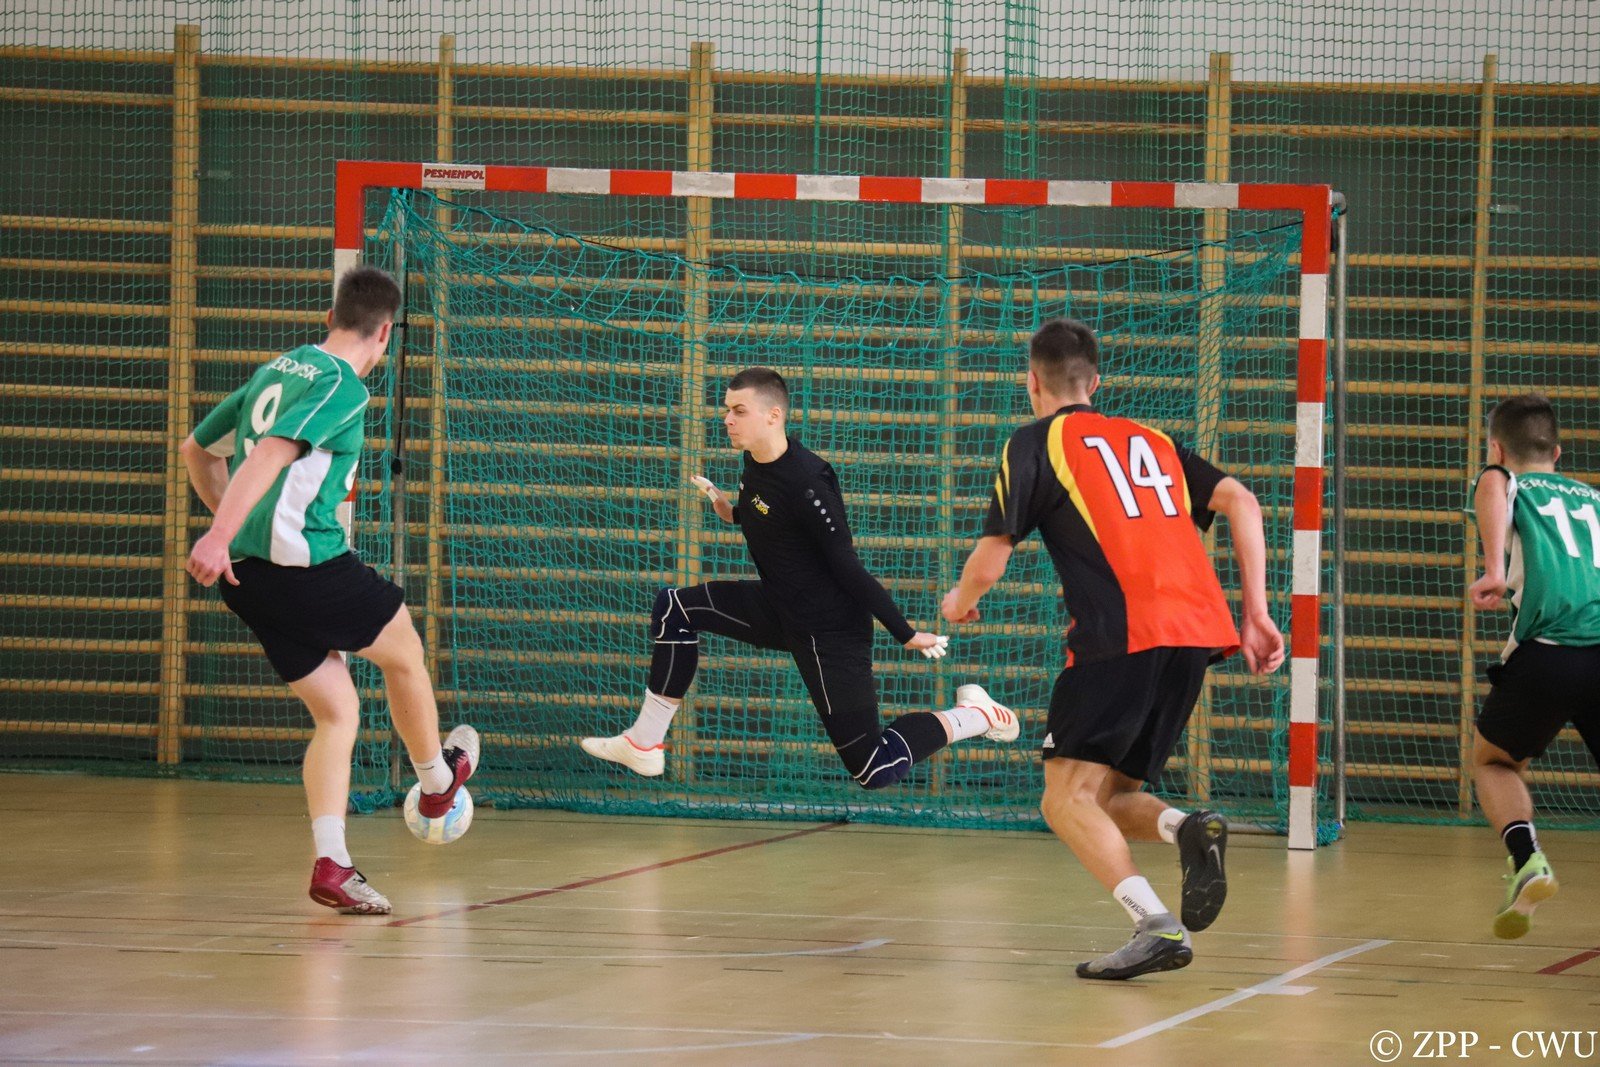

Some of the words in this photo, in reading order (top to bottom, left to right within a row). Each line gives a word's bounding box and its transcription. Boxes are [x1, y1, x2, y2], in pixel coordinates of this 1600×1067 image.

[424, 169, 485, 180] PESMENPOL
[1081, 435, 1179, 519] 14
[1536, 497, 1600, 569] 11
